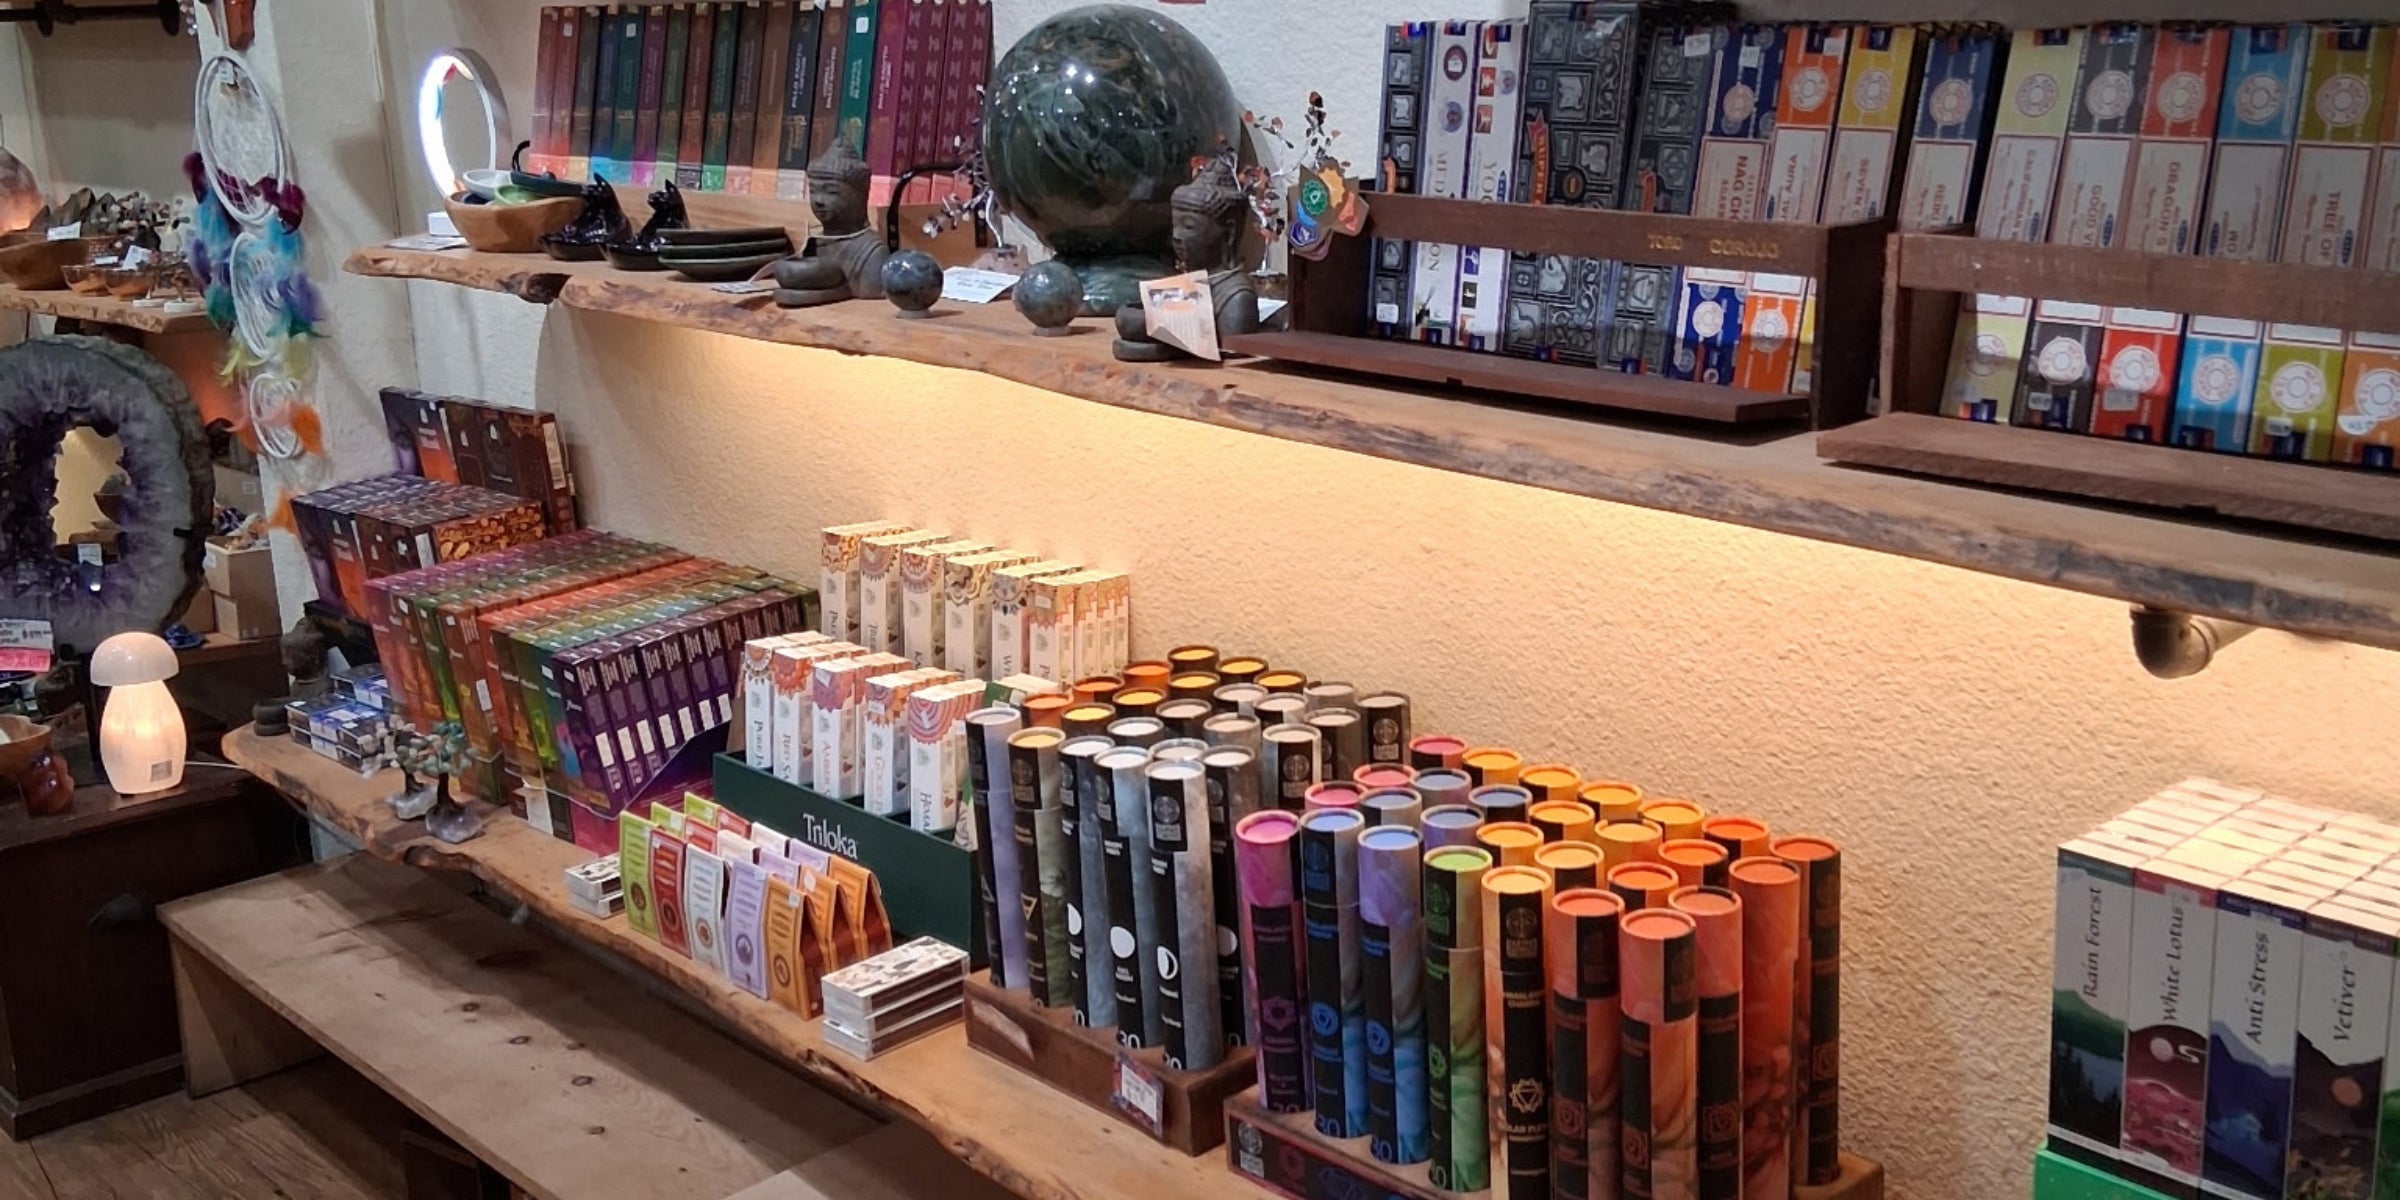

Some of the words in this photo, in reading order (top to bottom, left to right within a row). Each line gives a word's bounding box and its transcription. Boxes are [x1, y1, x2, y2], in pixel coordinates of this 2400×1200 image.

[1733, 155, 1749, 194] NAG
[1785, 154, 1798, 194] AURA
[1854, 158, 1870, 203] SEVEN
[1729, 197, 1744, 222] CH
[1931, 183, 1946, 221] REIKI
[2088, 184, 2102, 228] GOOD
[2323, 191, 2341, 235] TREE
[2320, 238, 2333, 258] OF
[802, 812, 859, 861] Triloka
[2085, 886, 2103, 947] Forest
[2166, 906, 2185, 961] Lotus
[2083, 952, 2099, 998] Rain
[2249, 931, 2270, 996] Stress
[2159, 965, 2181, 1022] White
[2332, 963, 2356, 1041] Vetiver
[2245, 997, 2264, 1045] Anti
